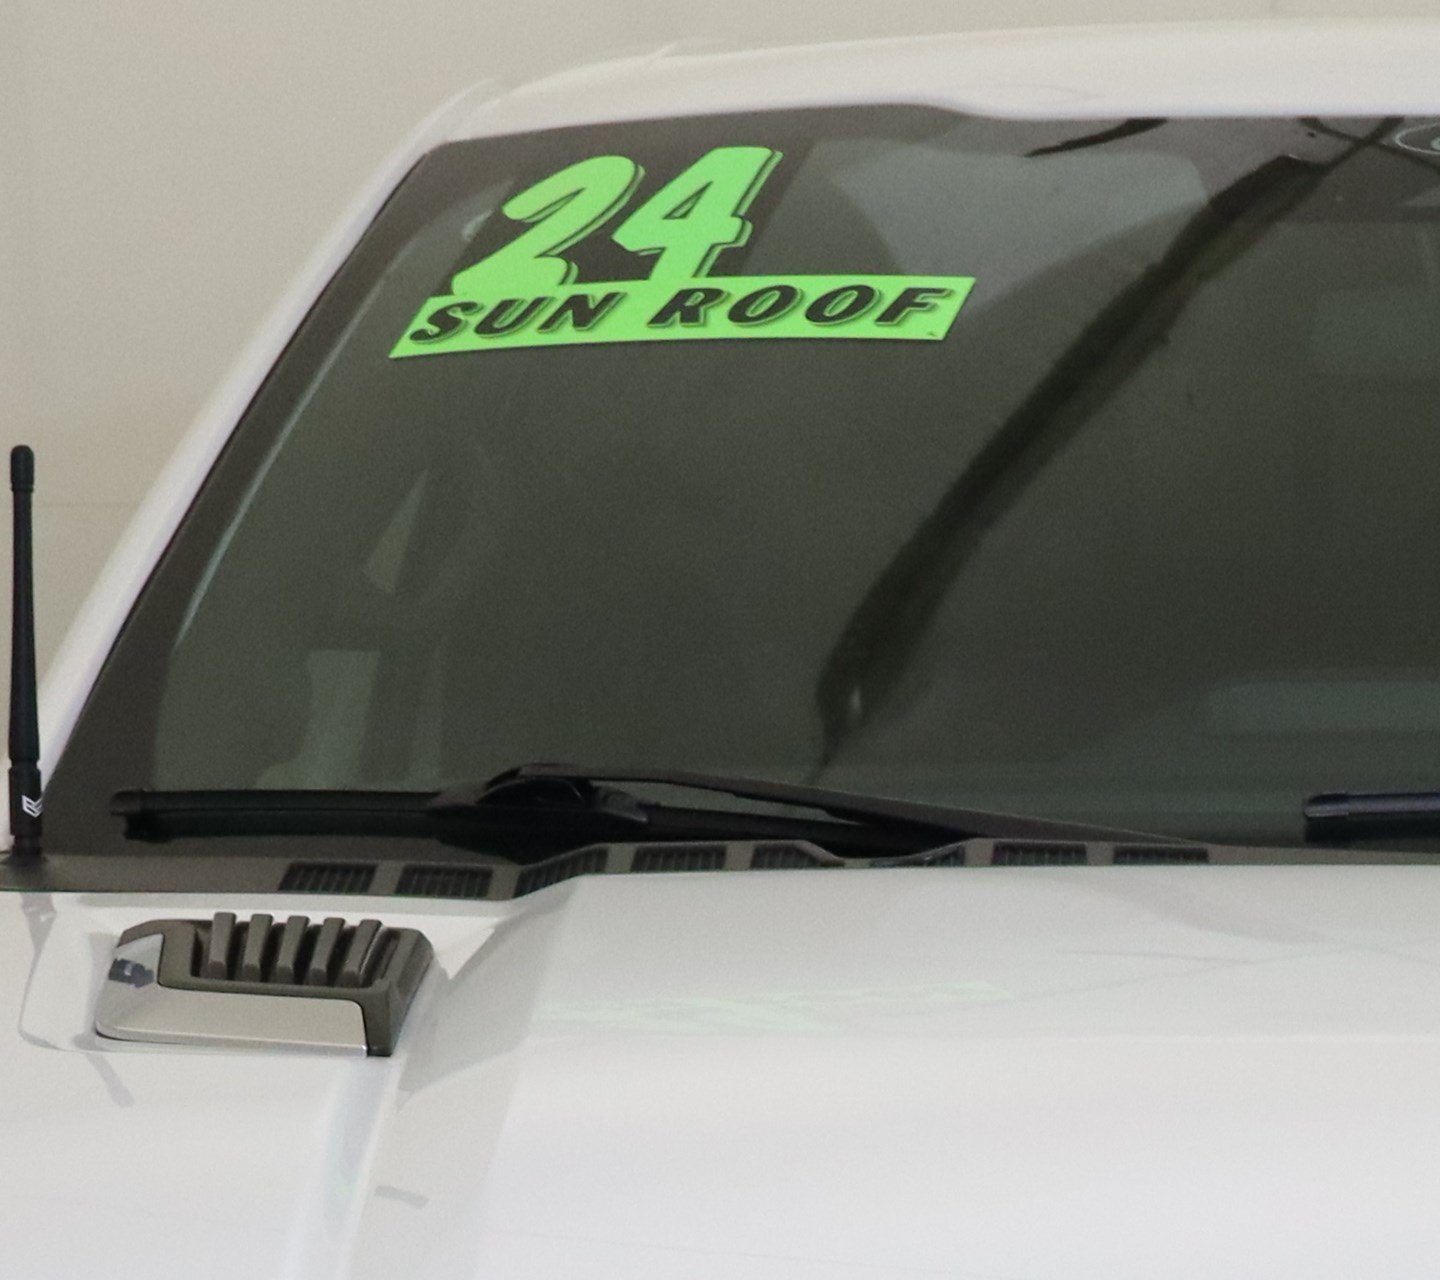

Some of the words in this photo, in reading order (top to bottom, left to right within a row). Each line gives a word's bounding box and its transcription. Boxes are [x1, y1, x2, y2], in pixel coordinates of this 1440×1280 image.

[451, 146, 783, 294] 24
[409, 291, 628, 344] SUN
[647, 284, 955, 328] ROOF
